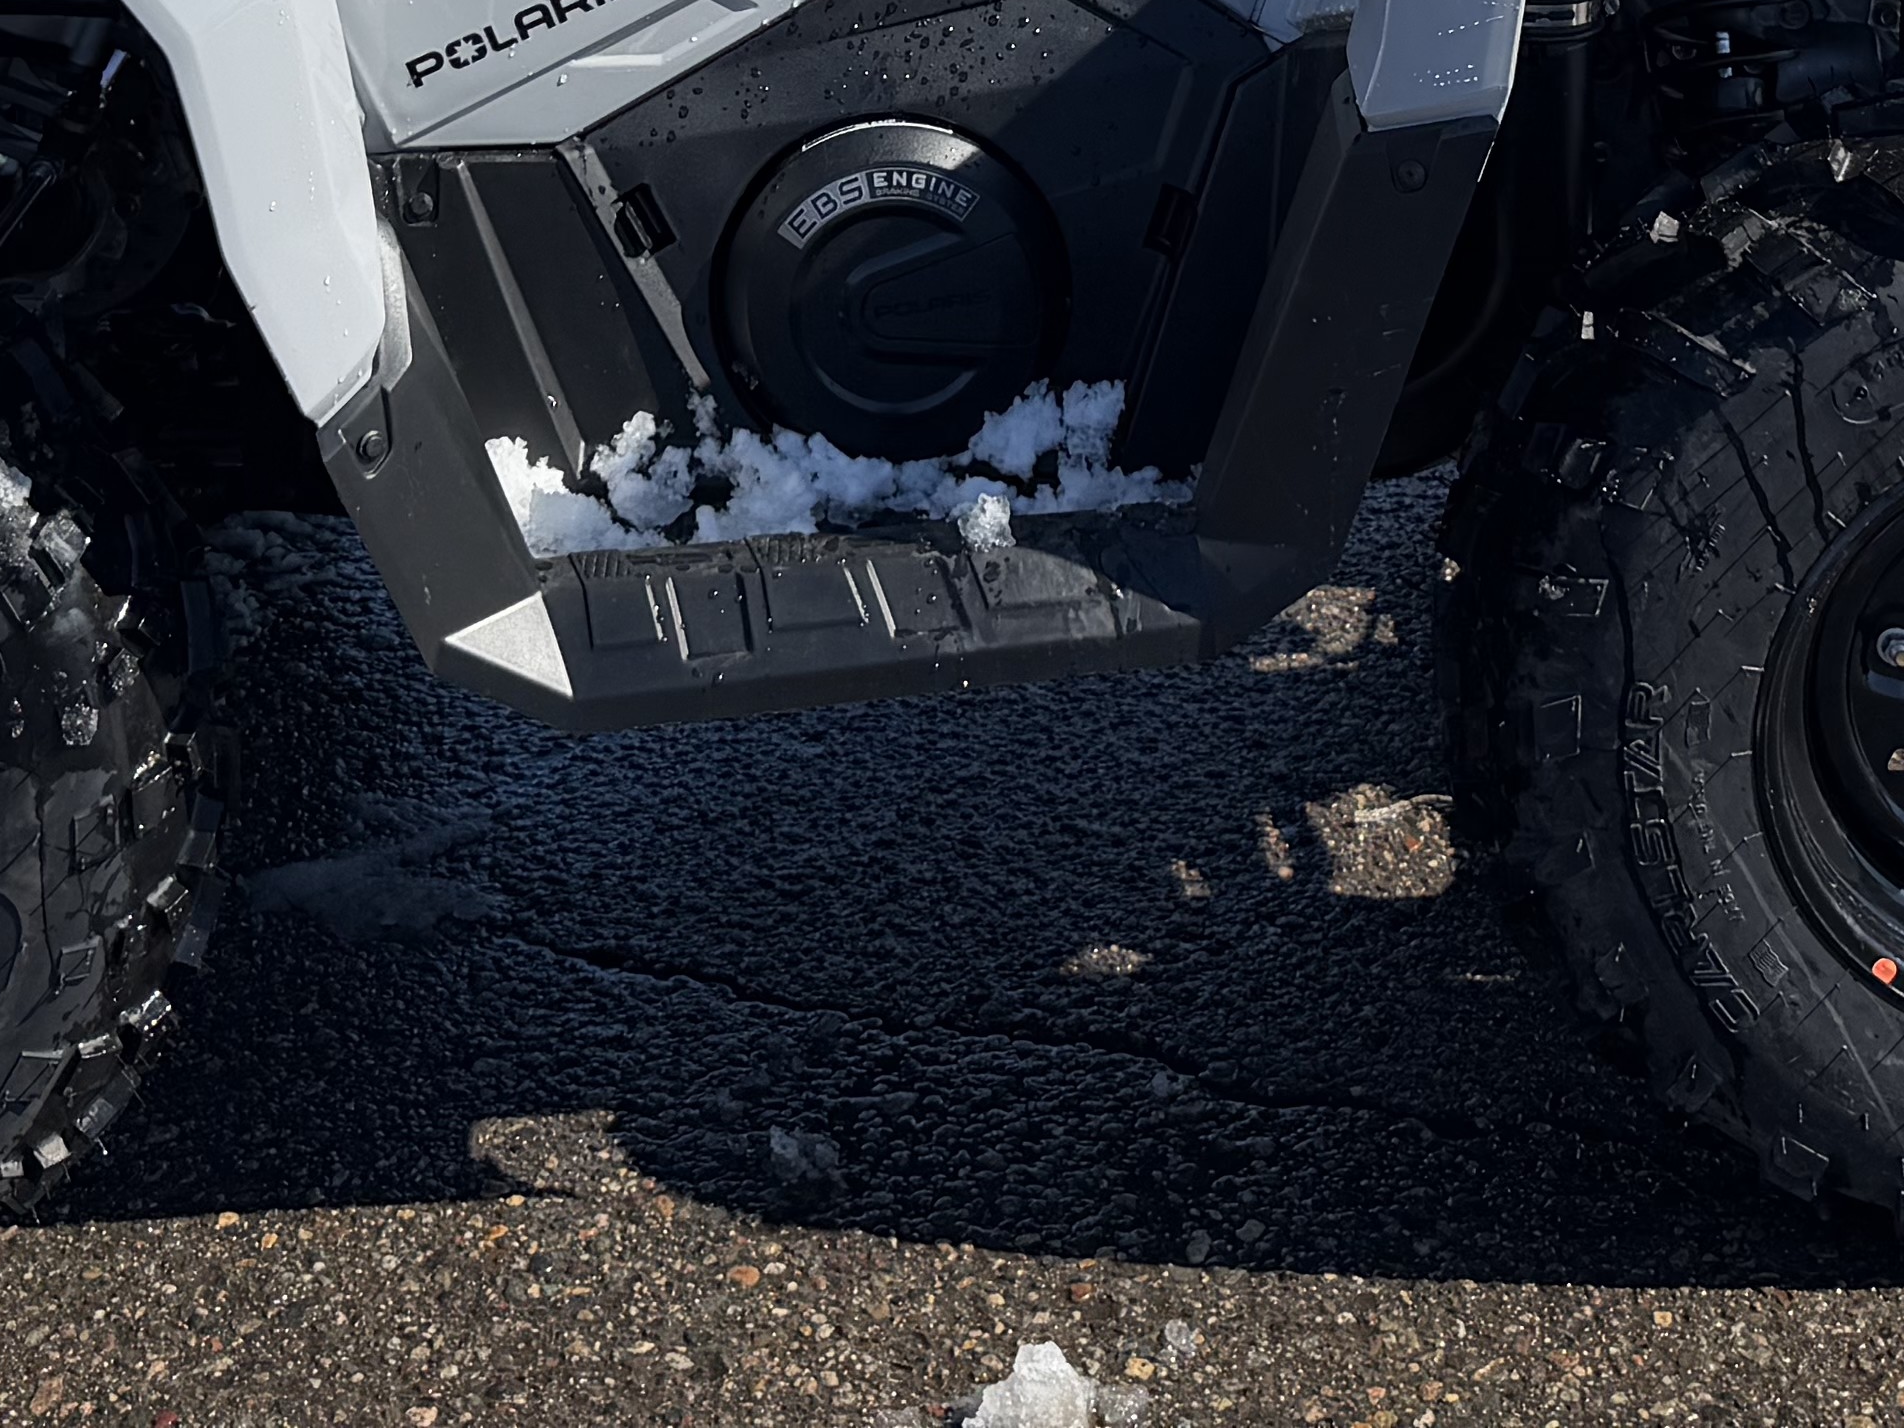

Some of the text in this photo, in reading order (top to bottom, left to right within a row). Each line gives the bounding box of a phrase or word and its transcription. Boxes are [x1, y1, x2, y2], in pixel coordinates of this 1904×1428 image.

[787, 170, 973, 240] EBS ENGINE
[1622, 681, 1760, 1033] CARLSTAR
